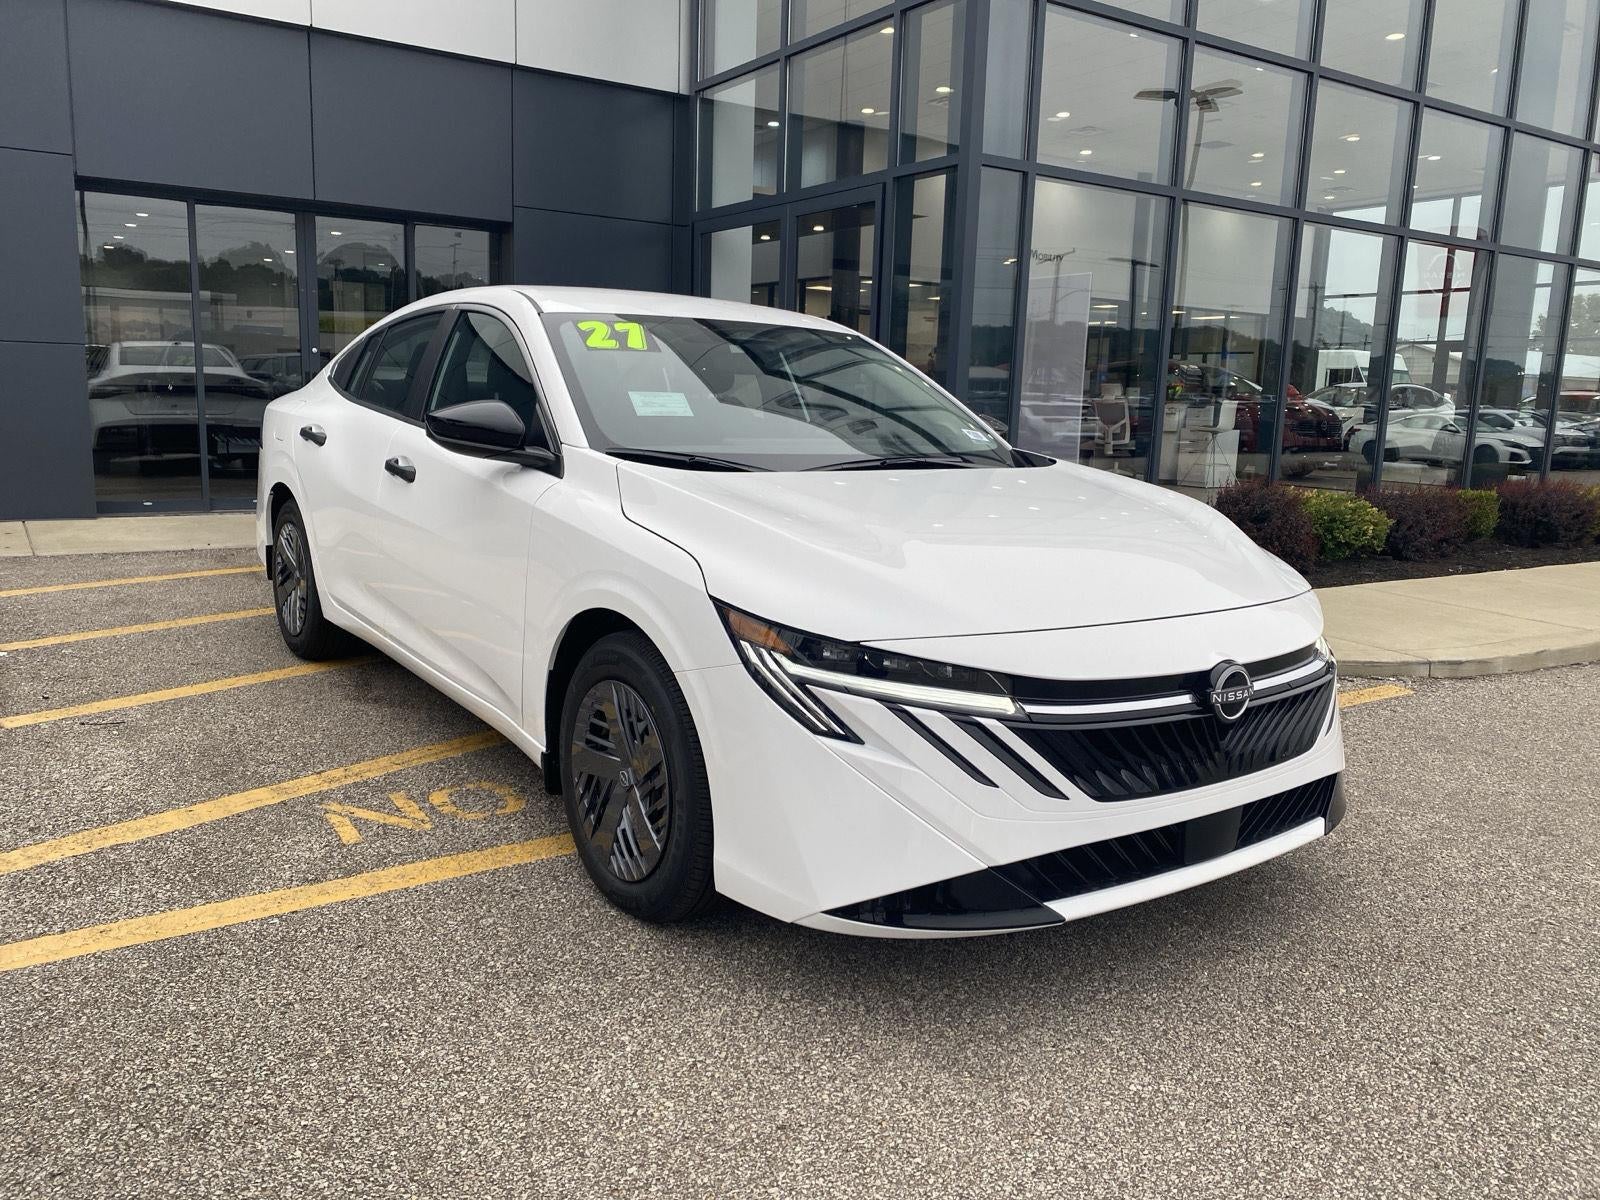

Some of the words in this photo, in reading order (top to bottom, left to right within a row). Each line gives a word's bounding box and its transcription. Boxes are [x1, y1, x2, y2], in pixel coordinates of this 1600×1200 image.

[577, 321, 647, 350] 27
[1213, 688, 1254, 703] NISSAN
[320, 780, 527, 846] NO
